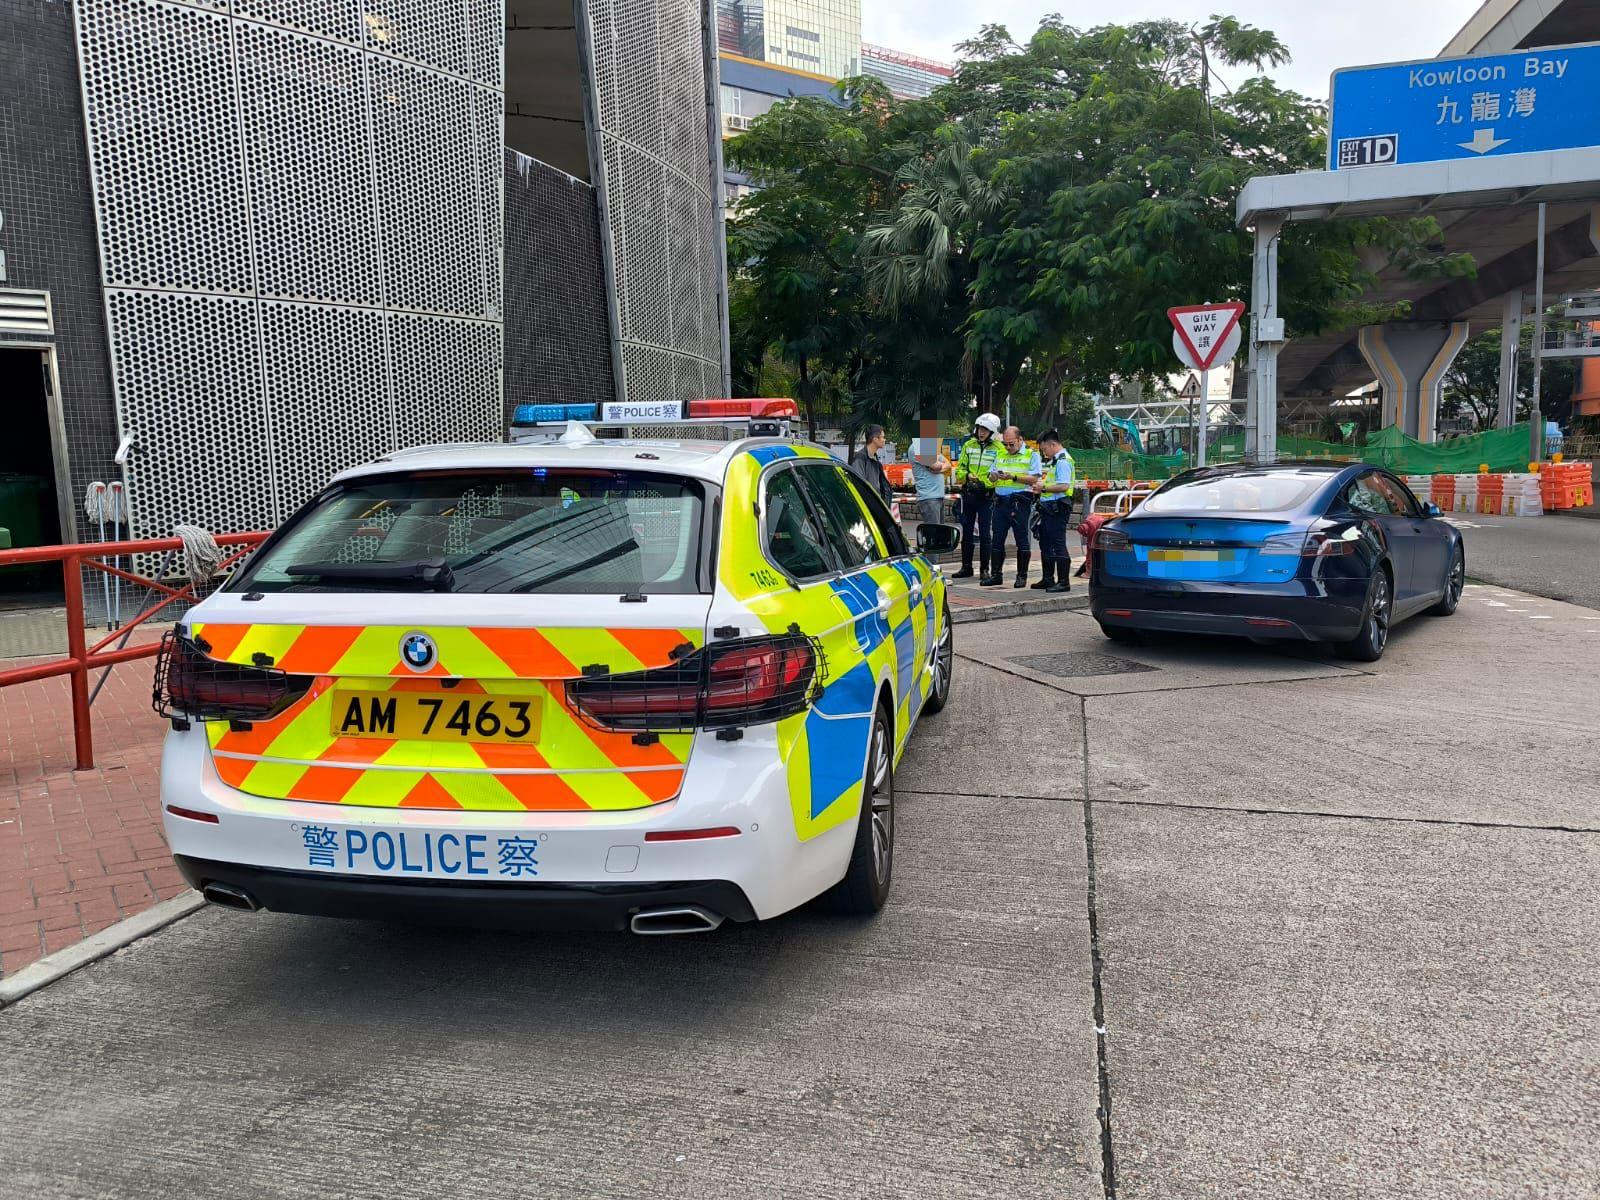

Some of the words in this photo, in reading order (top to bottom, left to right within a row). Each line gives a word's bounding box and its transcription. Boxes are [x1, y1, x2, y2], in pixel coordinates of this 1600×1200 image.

[1409, 65, 1506, 89] Kowloon
[1524, 57, 1569, 78] Bay
[1436, 86, 1537, 125] 九龍灣
[1341, 140, 1360, 152] EXIT
[1341, 152, 1358, 165] 出
[1362, 138, 1394, 163] 1D
[1192, 313, 1217, 323] GIVE
[1193, 323, 1217, 333] WAY
[624, 406, 661, 417] POLICE
[662, 403, 678, 418] 察
[341, 697, 397, 734] AM
[418, 699, 531, 738] 7463
[302, 825, 339, 868] 警
[346, 829, 489, 875] POLICE
[497, 836, 539, 877] 察
